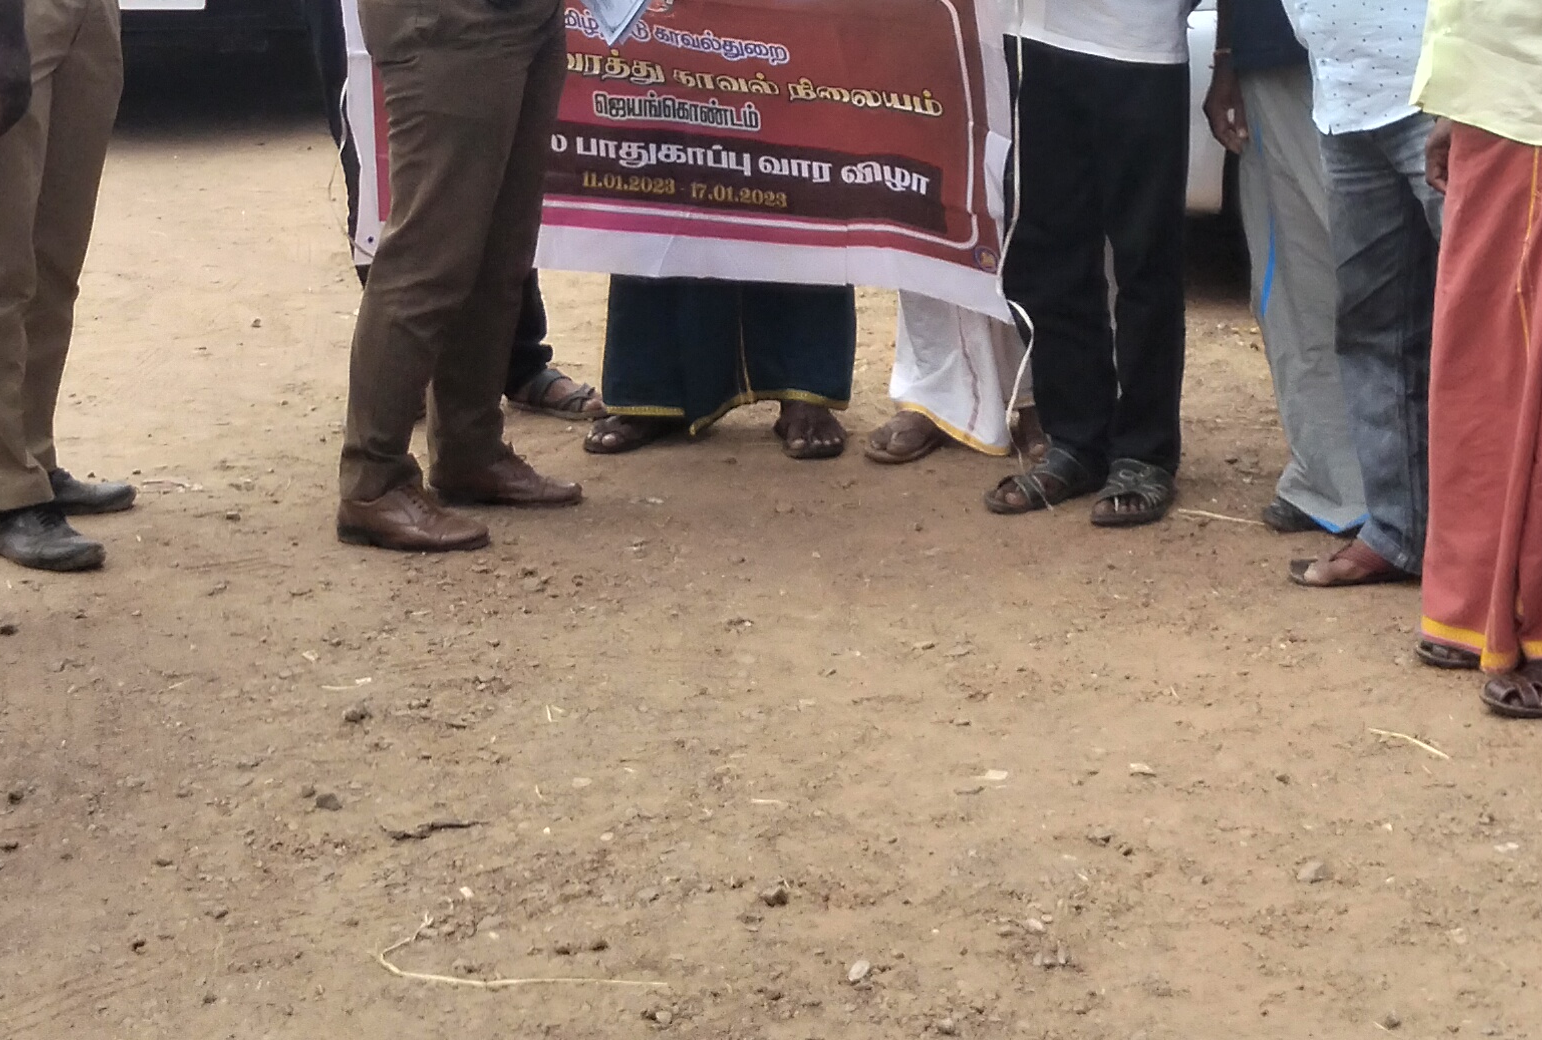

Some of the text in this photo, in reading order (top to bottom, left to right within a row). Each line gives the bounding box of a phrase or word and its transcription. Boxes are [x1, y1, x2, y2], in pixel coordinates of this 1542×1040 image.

[653, 24, 790, 64] காவல்துறை
[593, 90, 762, 132] ஜெயங்கொண்டம்
[673, 69, 780, 97] காவல்
[787, 77, 944, 118] நிலையம்
[576, 136, 752, 177] பாதுகாப்பு
[758, 155, 833, 184] வார
[840, 161, 931, 196] விழா
[582, 170, 676, 196] 11.01.2023
[690, 182, 789, 209] 17.01.2023
